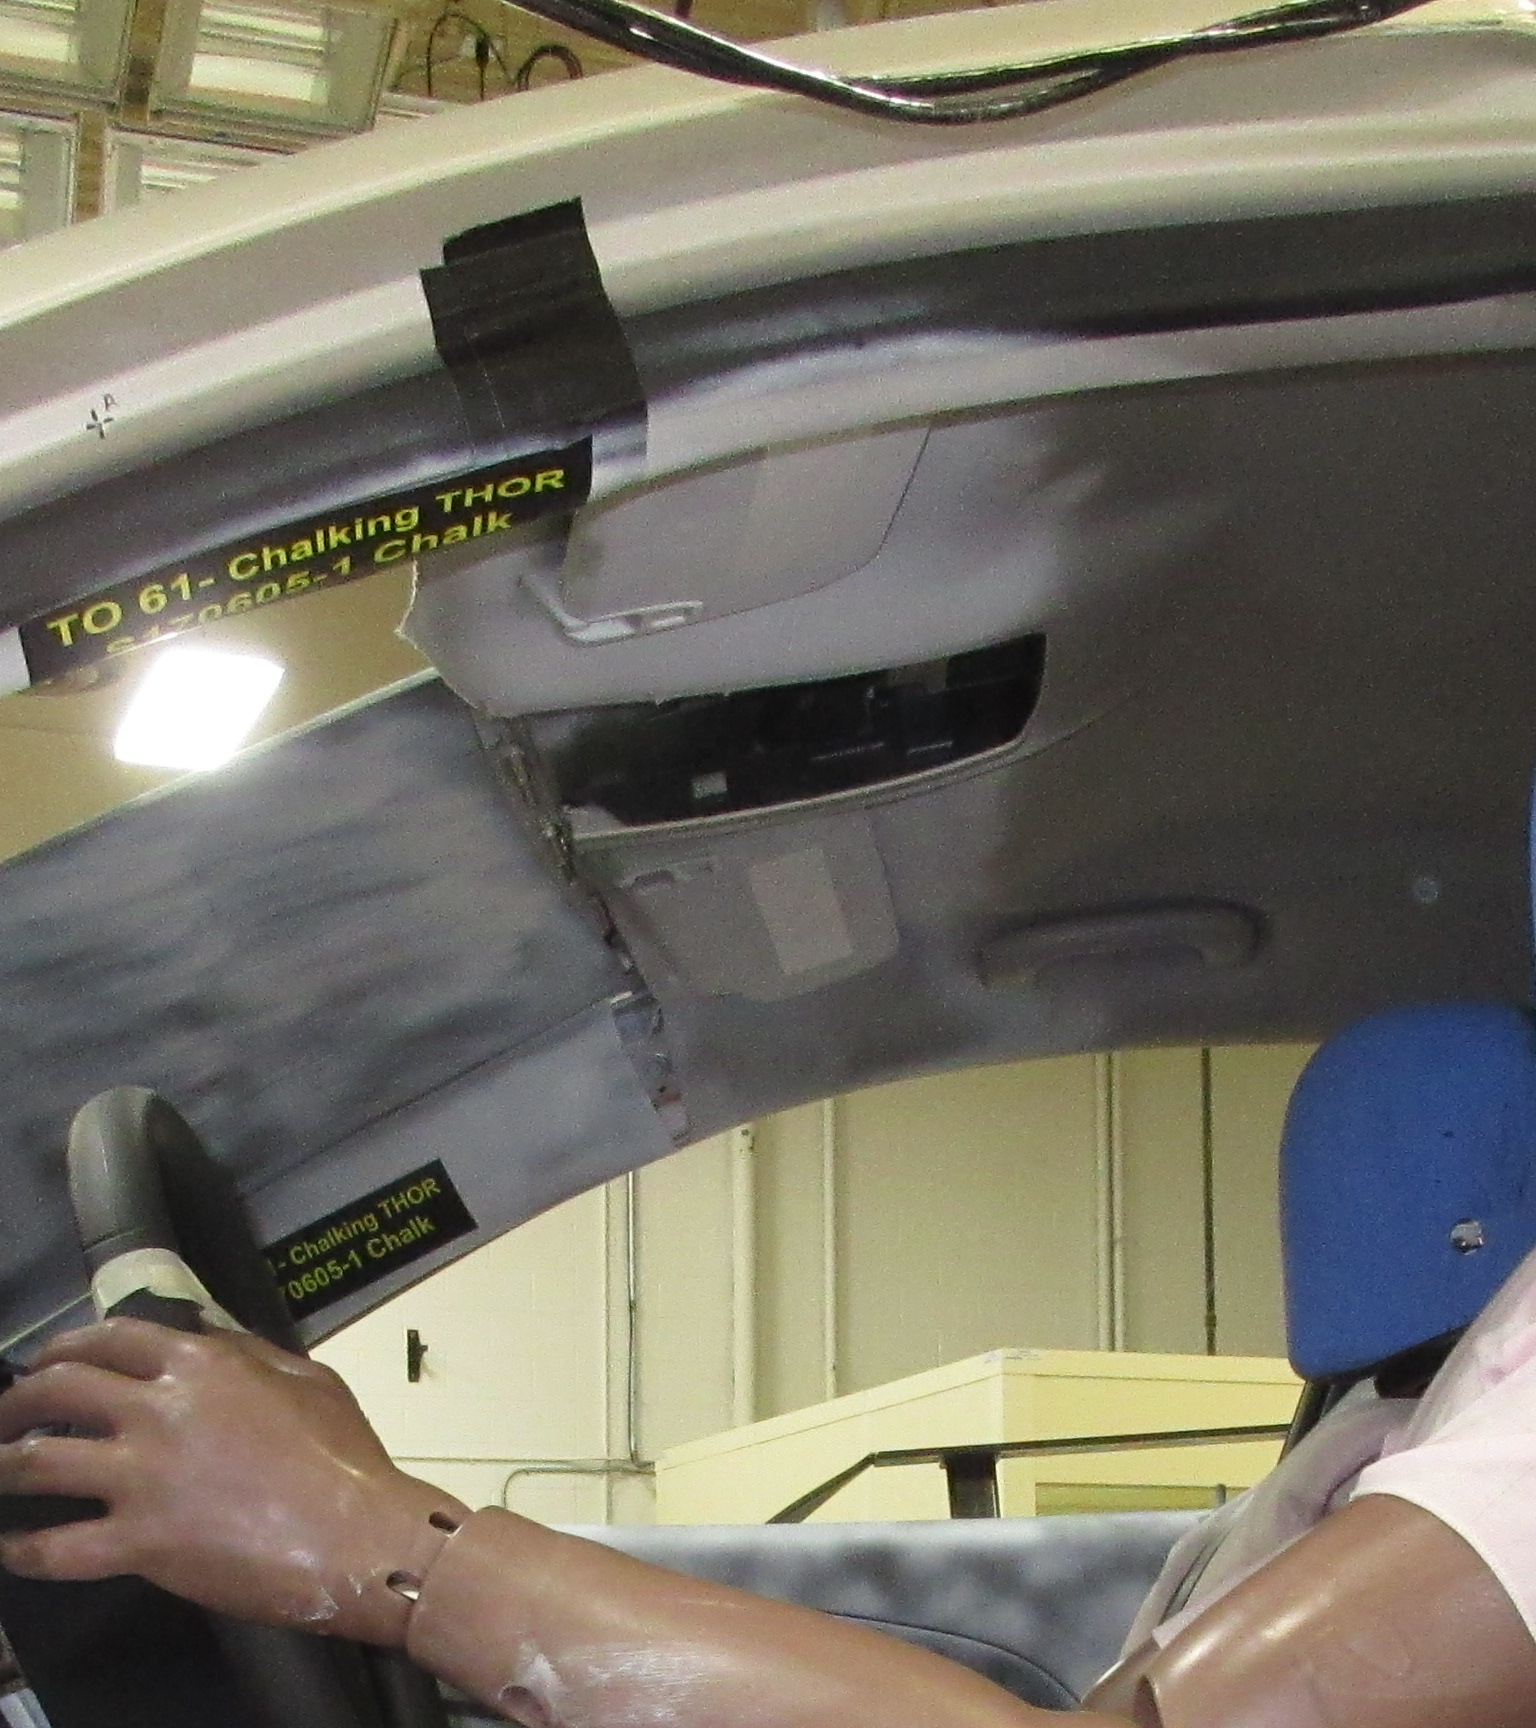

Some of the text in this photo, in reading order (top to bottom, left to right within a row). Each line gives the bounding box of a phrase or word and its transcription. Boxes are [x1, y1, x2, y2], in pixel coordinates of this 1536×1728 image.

[46, 469, 565, 647] TO 61- Chalking THOR
[373, 511, 513, 563] Chalk
[289, 1213, 379, 1265] Chalking
[378, 1178, 441, 1218] THOR
[366, 1215, 437, 1258] Chalk
